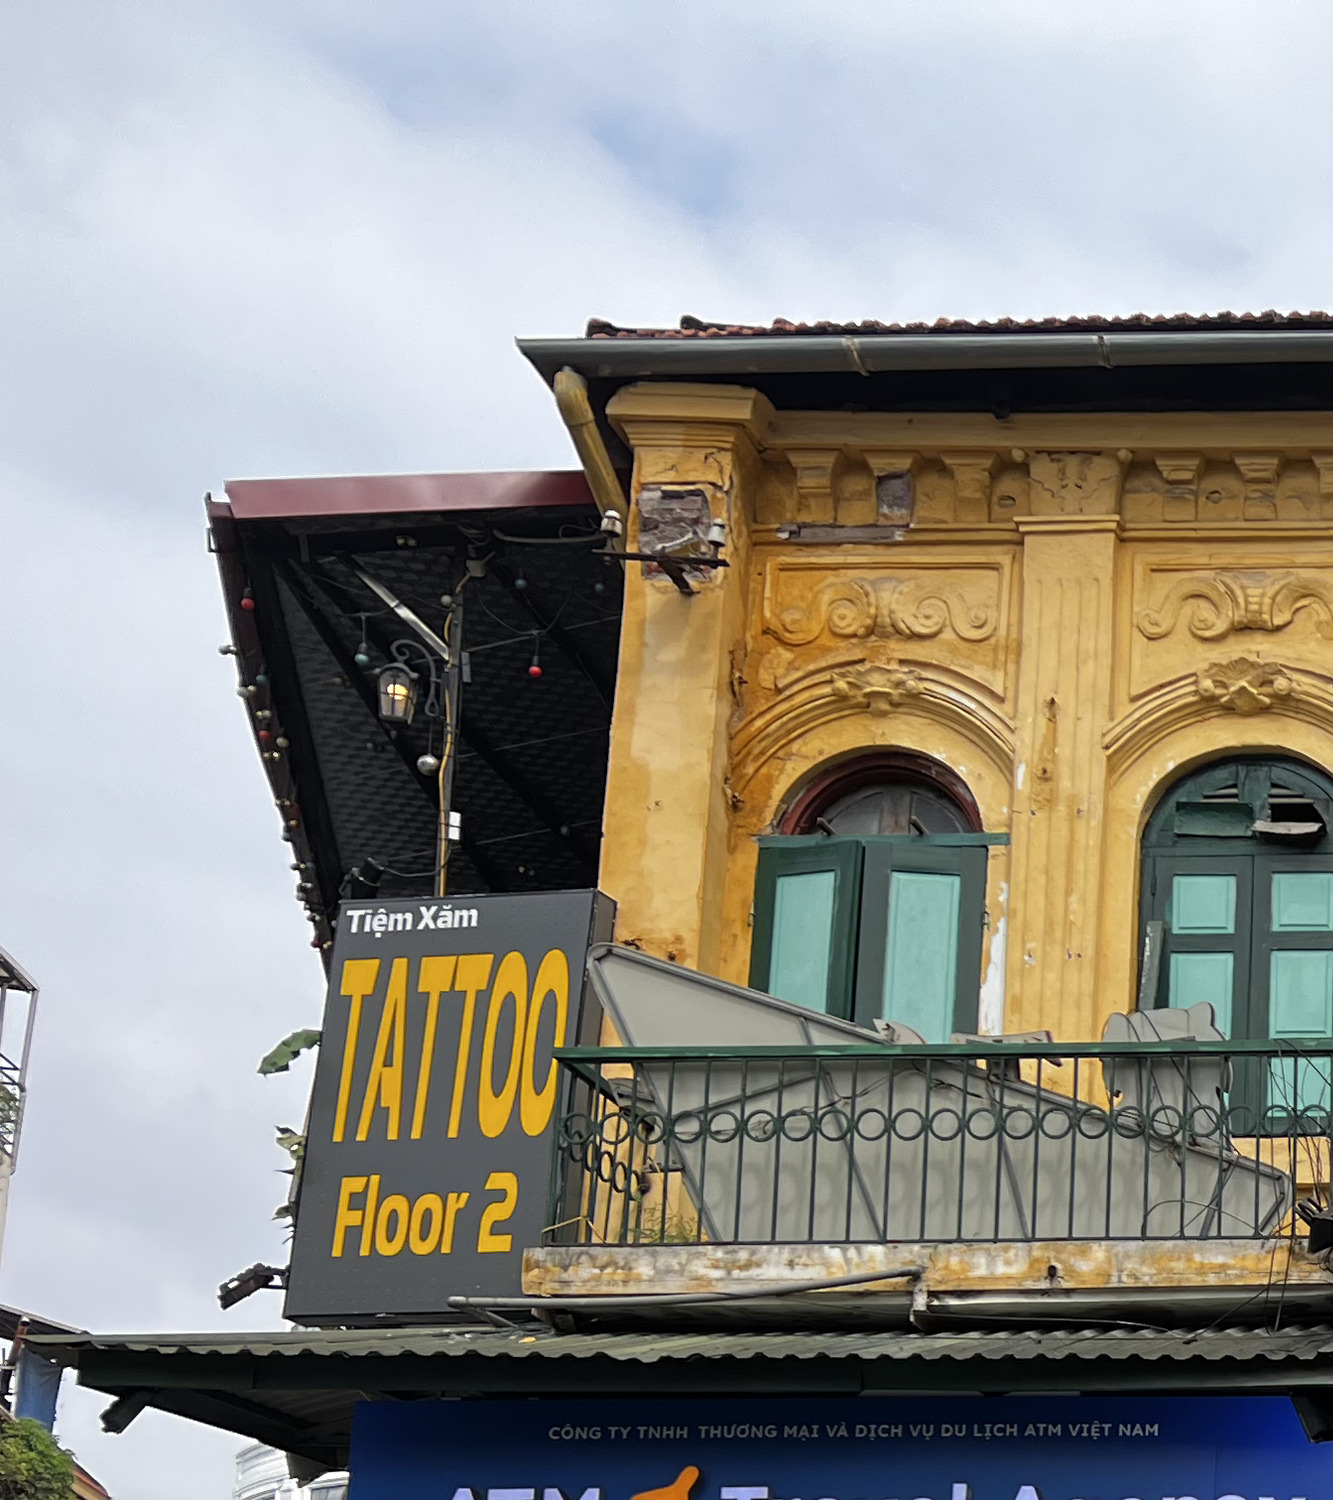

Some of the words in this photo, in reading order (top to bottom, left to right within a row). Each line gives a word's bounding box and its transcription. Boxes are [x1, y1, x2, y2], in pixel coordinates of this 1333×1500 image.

[346, 908, 412, 938] Tiệm
[417, 904, 478, 932] Xăm
[332, 947, 570, 1143] TATTOO
[331, 1174, 469, 1258] Floor
[477, 1171, 518, 1253] 2
[548, 1424, 602, 1440] CÔNG
[608, 1426, 631, 1440] TY
[637, 1426, 688, 1439] TNHH
[698, 1424, 778, 1439] THƯƠNG
[783, 1425, 820, 1442] MẠI
[855, 1424, 903, 1441] DỊCH
[909, 1424, 934, 1441] VỤ
[941, 1423, 967, 1438] DU
[973, 1423, 1018, 1441] LỊCH
[1024, 1423, 1062, 1437] ATM
[1068, 1420, 1111, 1441] VIỆT
[1118, 1423, 1159, 1437] NAM
